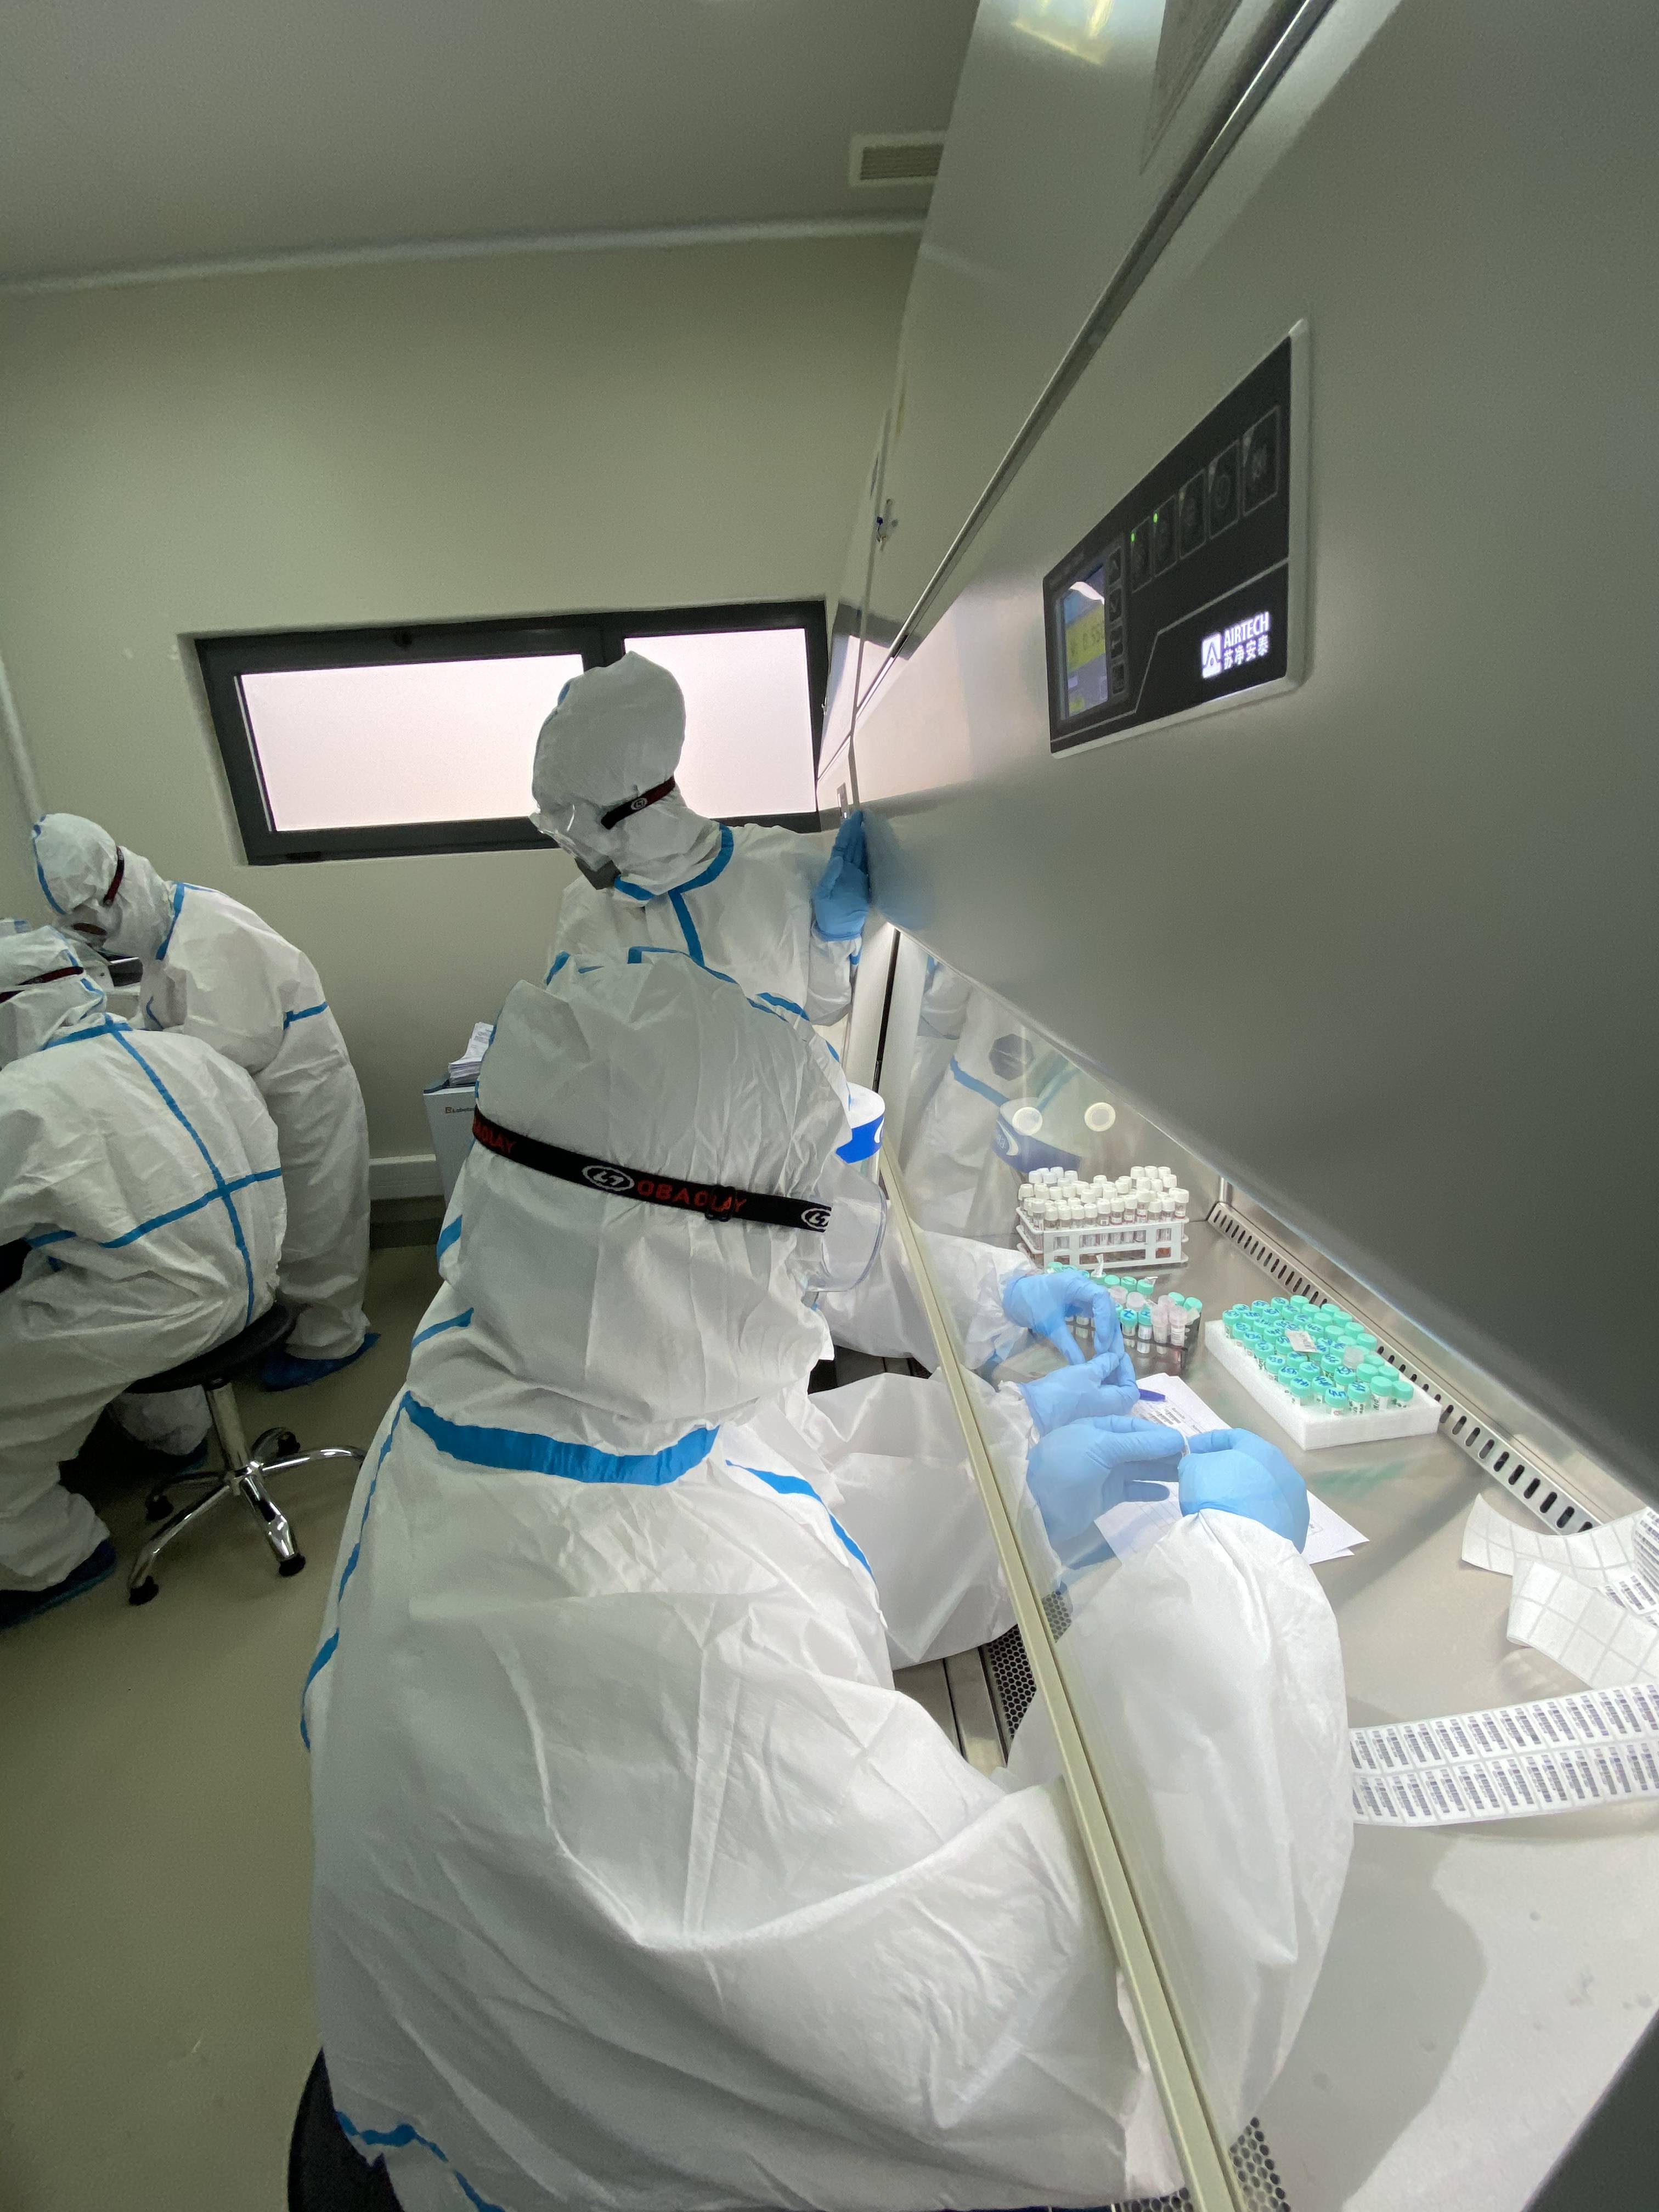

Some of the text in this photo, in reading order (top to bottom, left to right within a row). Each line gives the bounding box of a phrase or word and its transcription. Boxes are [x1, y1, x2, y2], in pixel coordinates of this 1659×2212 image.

[1223, 611, 1269, 648] AIRTECH
[1223, 634, 1269, 670] 苏净安泰
